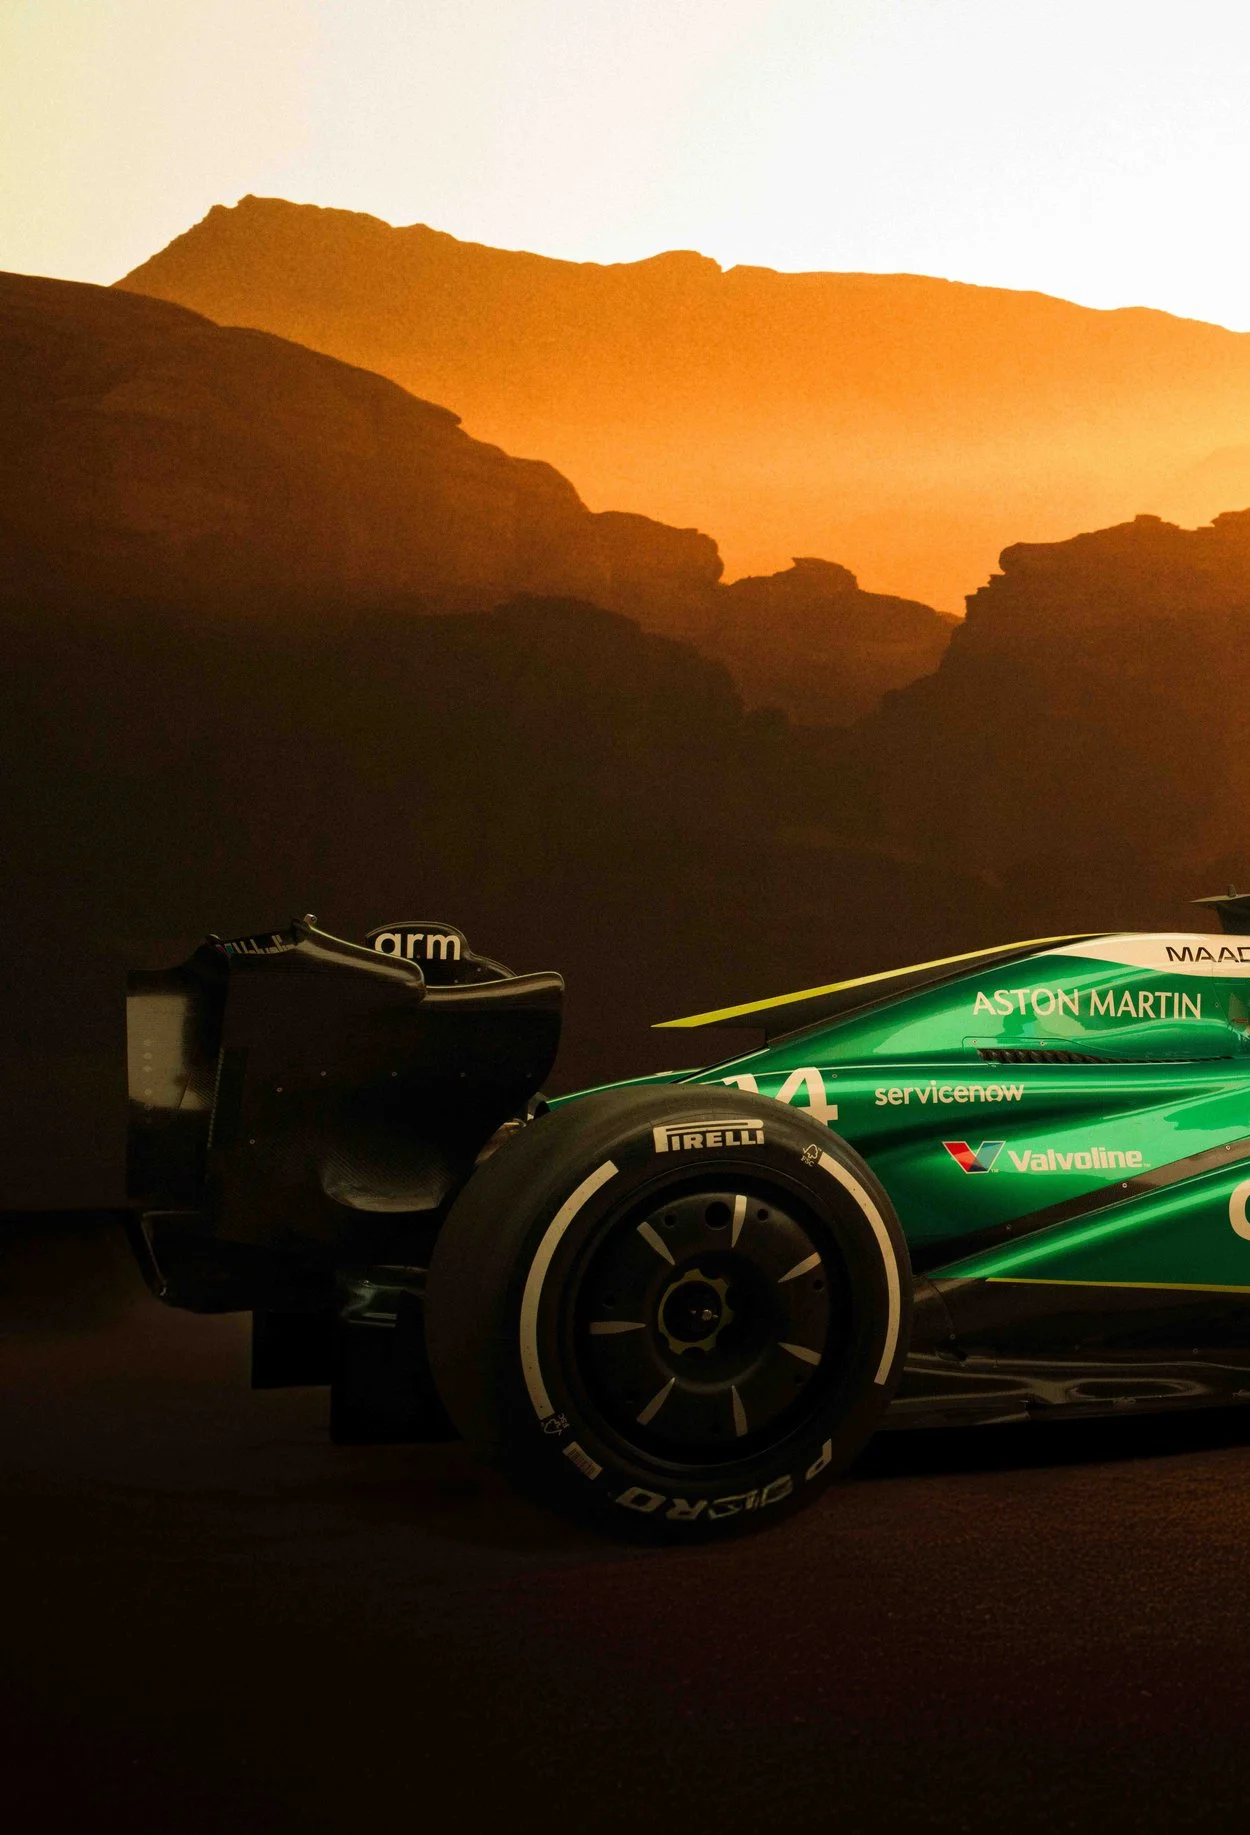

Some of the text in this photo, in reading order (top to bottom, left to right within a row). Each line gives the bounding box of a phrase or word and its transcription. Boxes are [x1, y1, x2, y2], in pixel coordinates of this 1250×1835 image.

[374, 932, 461, 961] arm
[972, 988, 1202, 1020] ASTON MARTIN
[874, 1080, 1025, 1106] servicenow
[652, 1119, 765, 1153] PIRELLI
[1007, 1147, 1144, 1172] Valvoline
[804, 1437, 833, 1482] P
